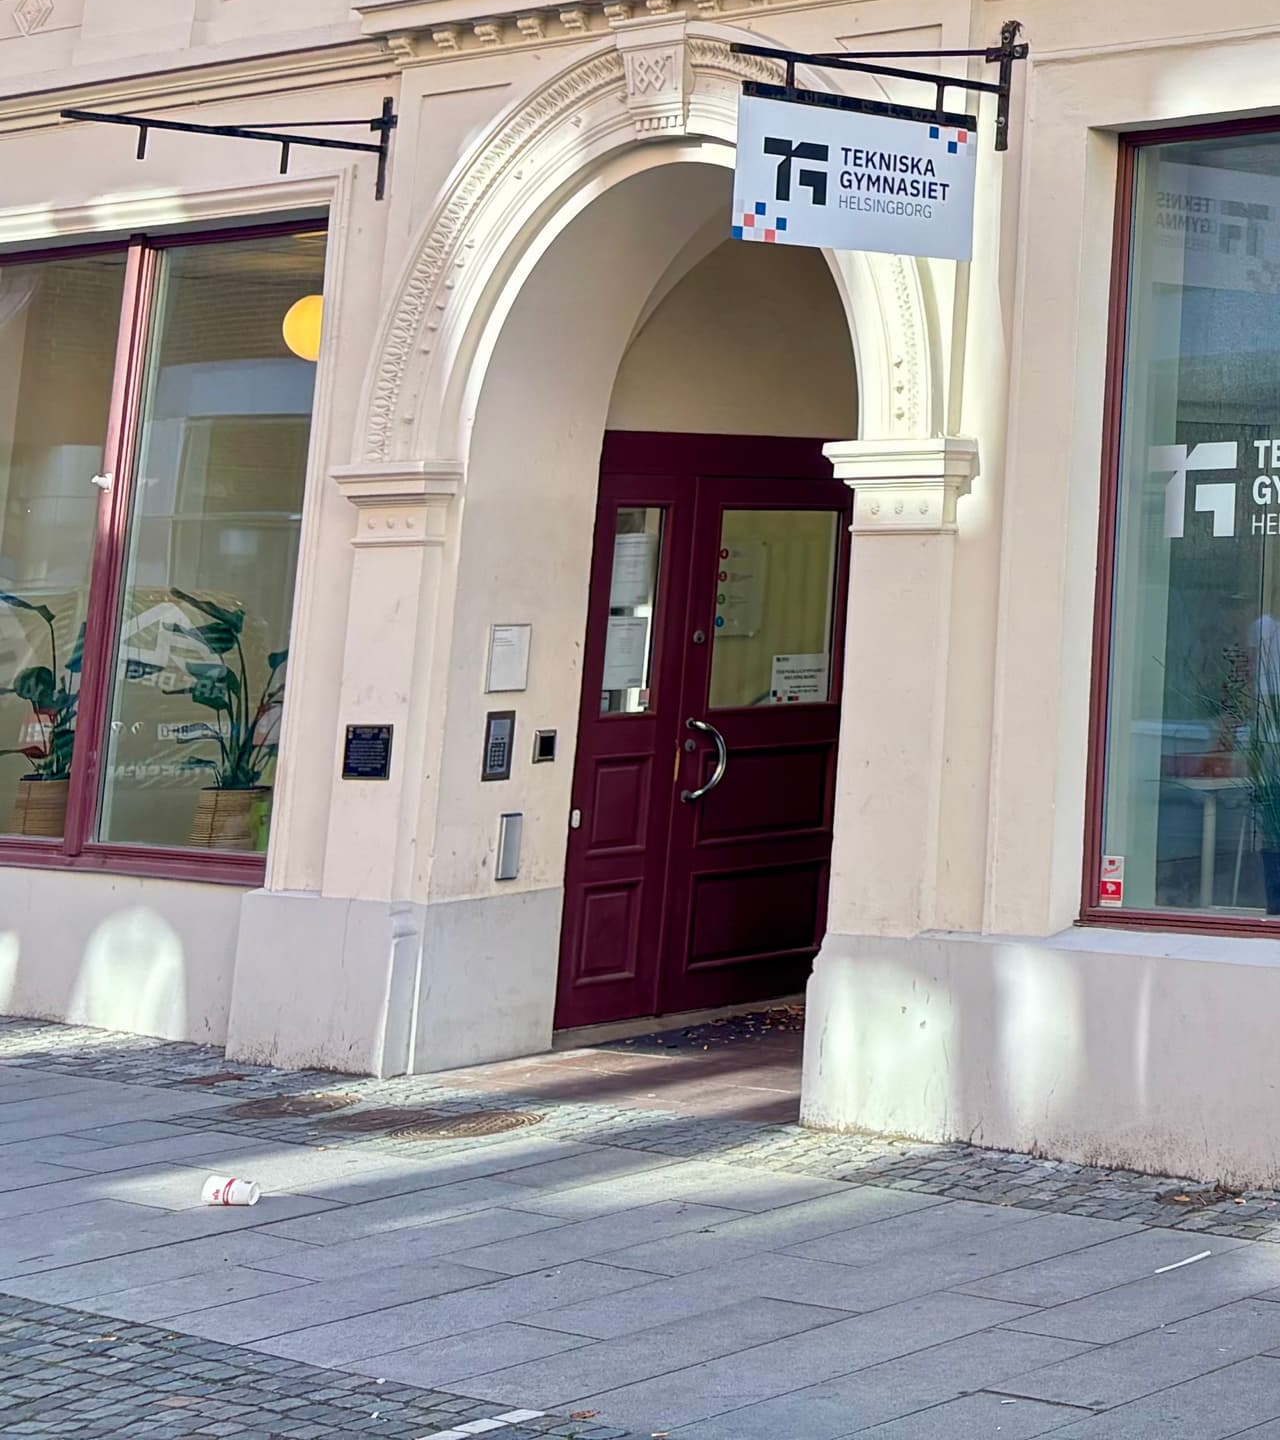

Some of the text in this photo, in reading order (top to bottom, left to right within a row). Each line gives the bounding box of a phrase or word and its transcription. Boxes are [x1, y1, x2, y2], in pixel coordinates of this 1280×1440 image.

[840, 146, 937, 178] TEKNISKA
[839, 171, 951, 202] GYMNASIET
[838, 194, 933, 219] HELSINGBORG
